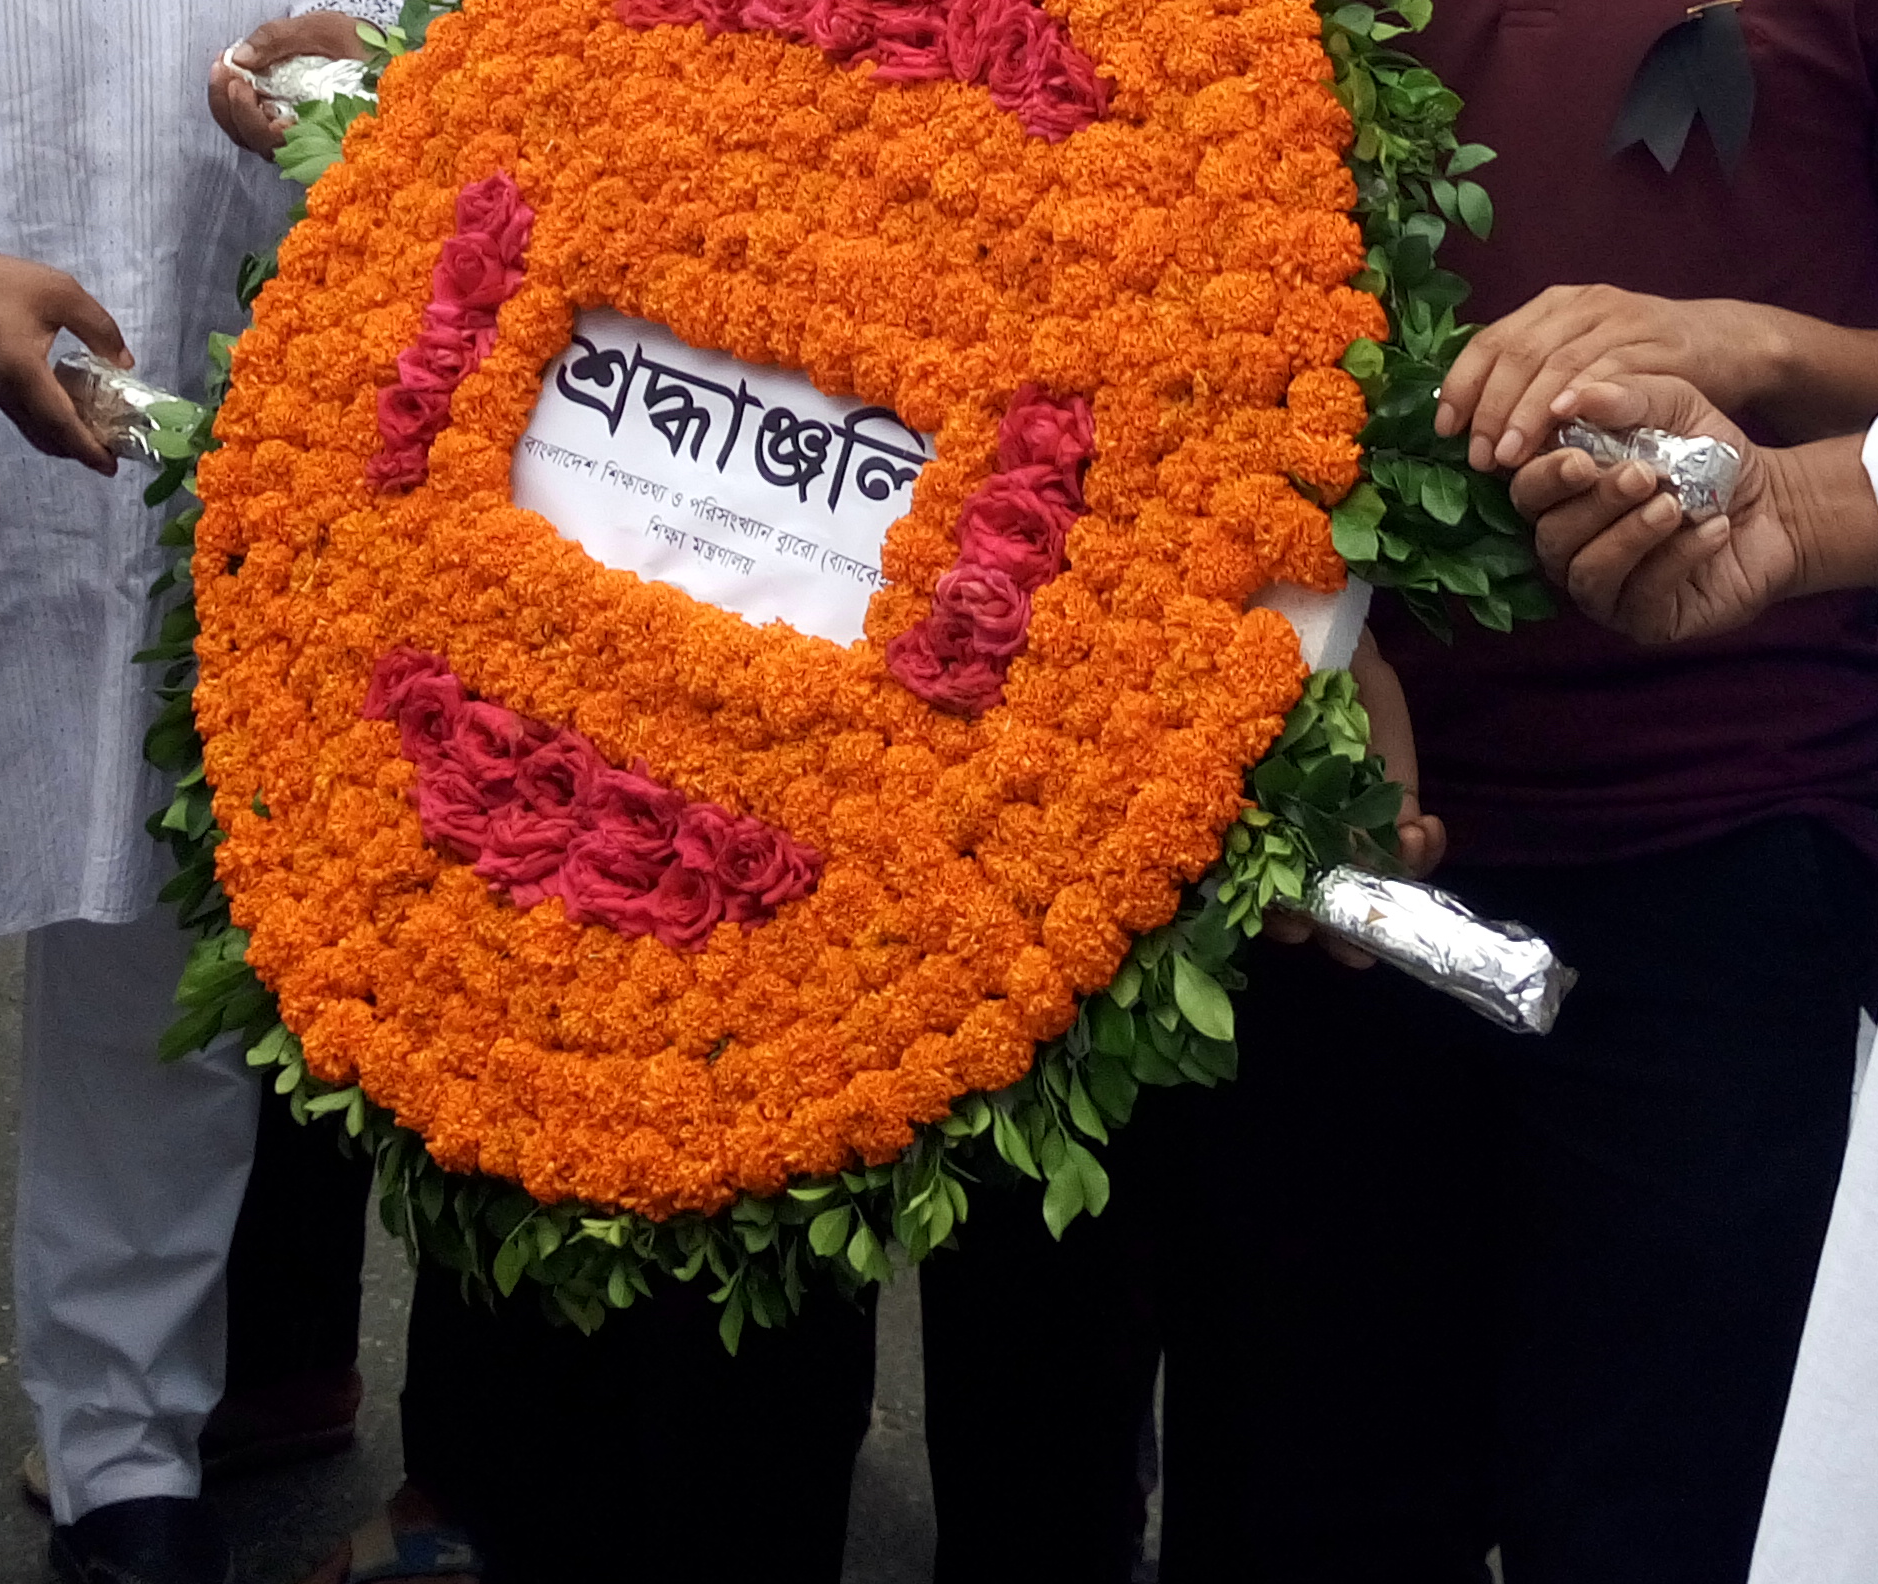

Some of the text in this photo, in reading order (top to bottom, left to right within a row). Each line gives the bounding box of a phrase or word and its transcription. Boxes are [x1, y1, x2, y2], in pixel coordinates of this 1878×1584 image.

[556, 333, 936, 514] শ্রদ্ধাঞ্জলি
[523, 434, 599, 479] বাংলাদেশ
[600, 461, 668, 502] শিক্ষাতথ্য
[671, 489, 684, 509] ও
[689, 495, 774, 544] পরিসংখ্যান
[776, 528, 819, 563] ব্যুরো
[644, 517, 758, 578] শিক্ষা মন্ত্রণালয়
